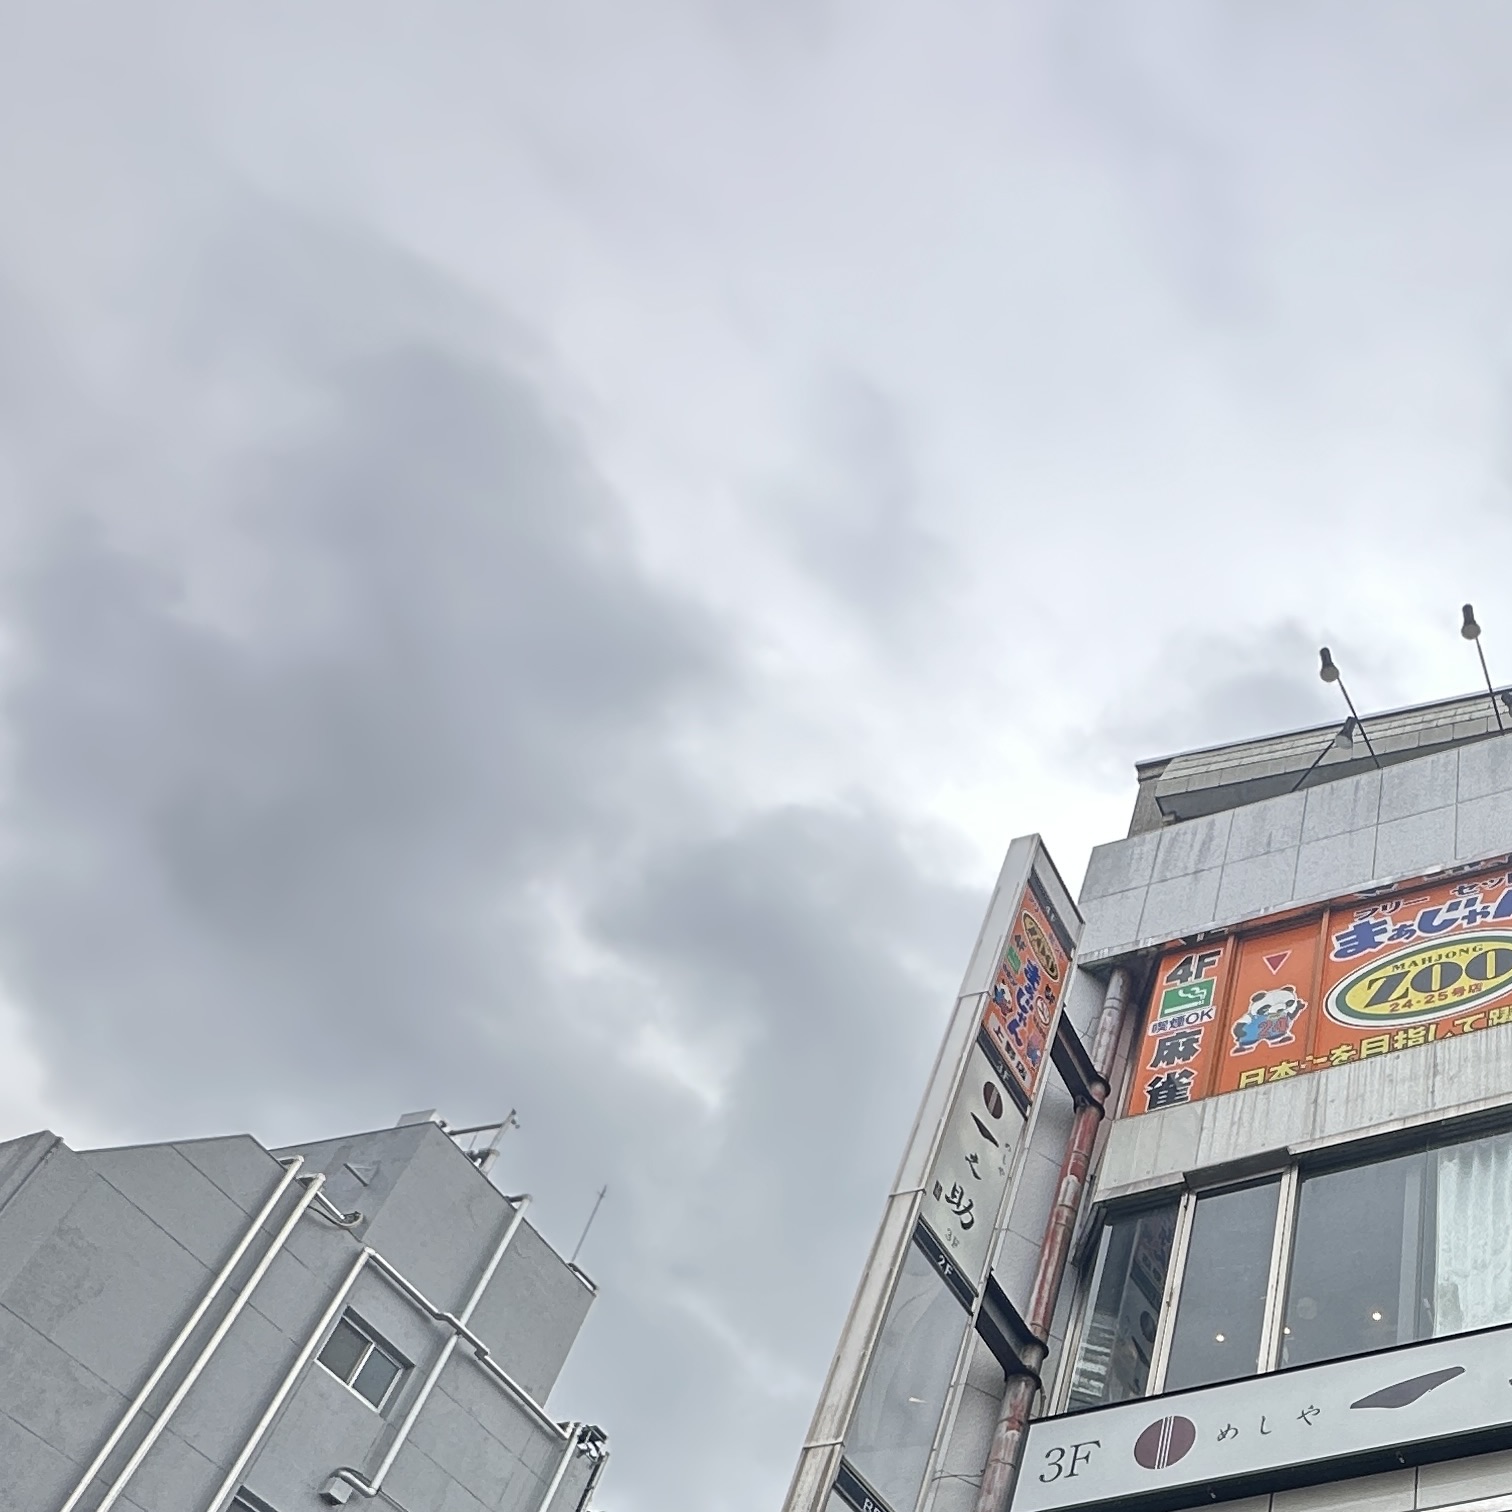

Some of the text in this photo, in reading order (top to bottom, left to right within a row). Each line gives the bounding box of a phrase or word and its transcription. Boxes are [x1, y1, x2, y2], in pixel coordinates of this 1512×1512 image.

[1355, 896, 1429, 921] フリー
[1163, 949, 1224, 986] 4F
[1392, 944, 1485, 973] MAHJONG
[1145, 1027, 1204, 1113] 麻雀
[937, 1253, 954, 1277] 2F
[1216, 1403, 1321, 1443] めしや
[1039, 1440, 1102, 1484] 3F
